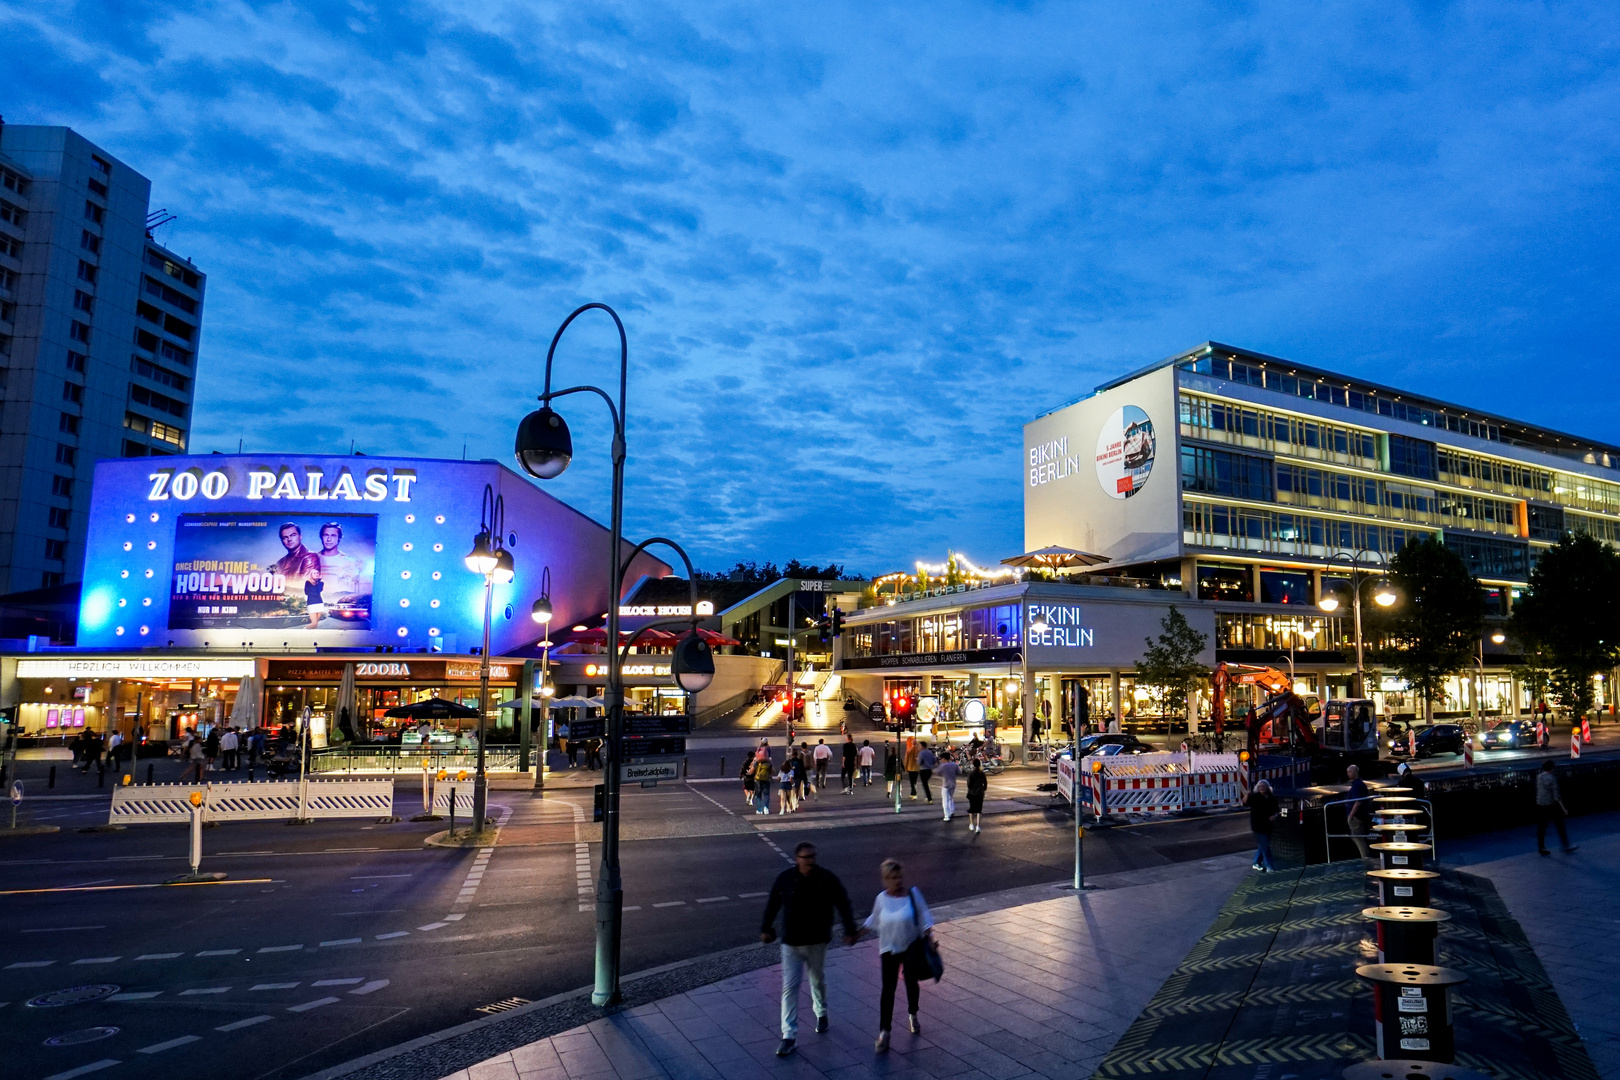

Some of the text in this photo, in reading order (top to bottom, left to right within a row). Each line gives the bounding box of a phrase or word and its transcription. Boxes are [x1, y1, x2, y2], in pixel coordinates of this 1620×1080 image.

[1030, 436, 1068, 466] BIKINI
[1109, 441, 1122, 450] JAHRE
[1096, 452, 1108, 462] BIKINI
[1108, 449, 1122, 458] BERLIN
[1030, 454, 1079, 487] BERLIN
[148, 471, 417, 502] ZOO PALAST
[175, 562, 192, 571] ONCE
[192, 560, 218, 572] UPON
[218, 562, 223, 570] A
[223, 561, 250, 574] TIME
[176, 572, 286, 594] HOLLYWOOD
[800, 580, 823, 592] SUPER
[197, 606, 238, 614] NUR IM KINO
[618, 606, 655, 615] BLOCK
[1028, 627, 1093, 647] BERLIN
[881, 653, 967, 666] SHOPPEN SCHNABULIEREN FLANIEREN
[69, 663, 201, 671] HERZLICH WILLKOMMEN
[355, 663, 410, 676] ZOOBA
